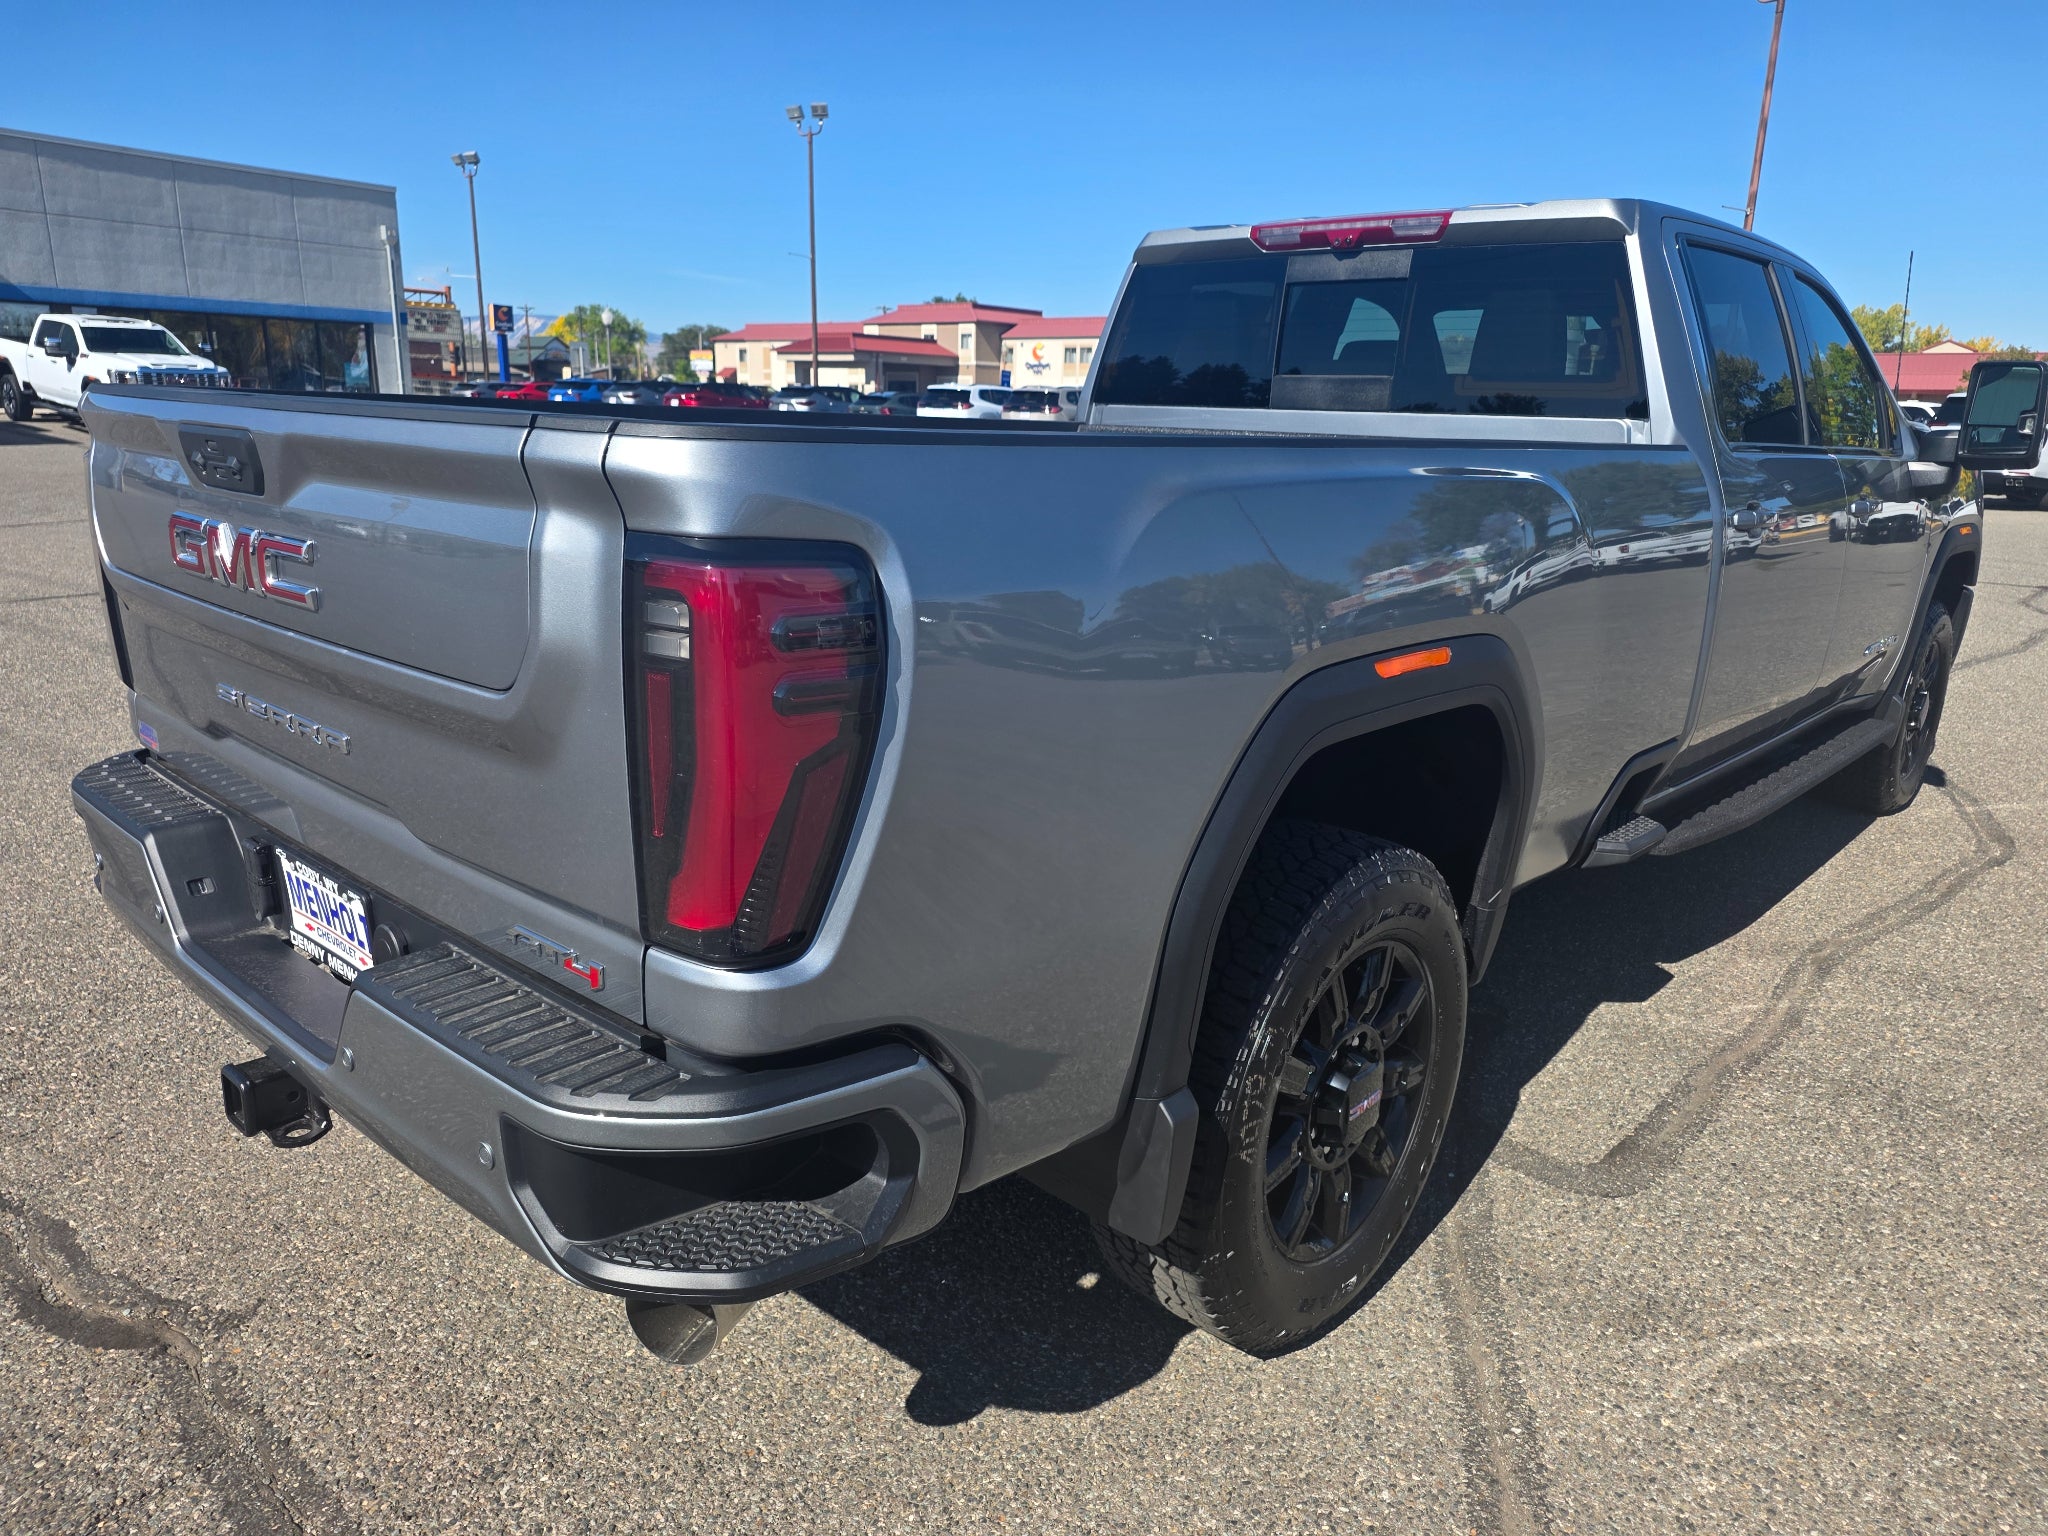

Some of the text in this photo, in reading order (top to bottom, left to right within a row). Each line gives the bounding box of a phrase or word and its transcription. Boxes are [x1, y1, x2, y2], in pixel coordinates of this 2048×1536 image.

[169, 511, 319, 613] GMC
[216, 682, 351, 755] SIERRA
[285, 870, 374, 954] MENHOLT
[290, 930, 326, 962] DENNY
[316, 927, 357, 960] CHEVROLET
[511, 923, 605, 992] AT4
